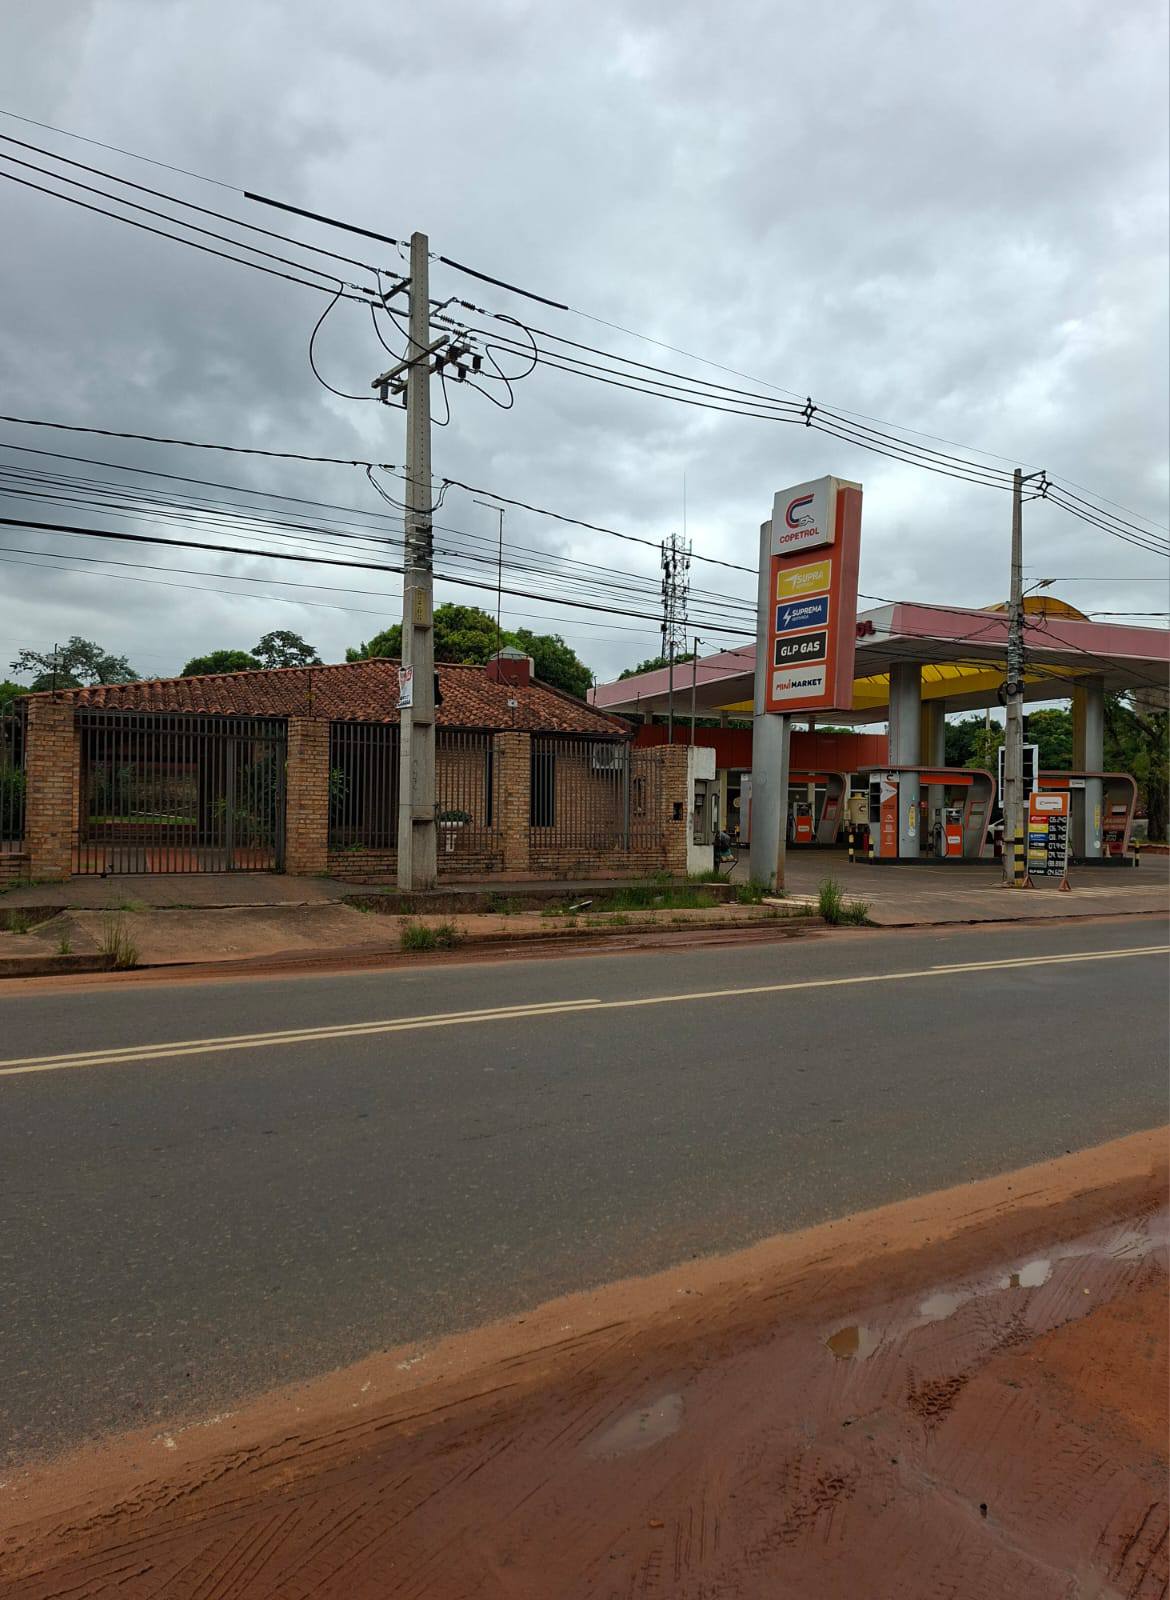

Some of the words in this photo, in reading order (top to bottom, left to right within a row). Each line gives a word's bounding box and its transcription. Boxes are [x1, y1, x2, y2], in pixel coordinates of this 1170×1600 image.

[779, 528, 820, 544] COPETROL
[796, 570, 824, 585] SUPRA
[791, 604, 822, 618] SUPREMA
[780, 644, 799, 657] GLP
[800, 640, 821, 654] GAS
